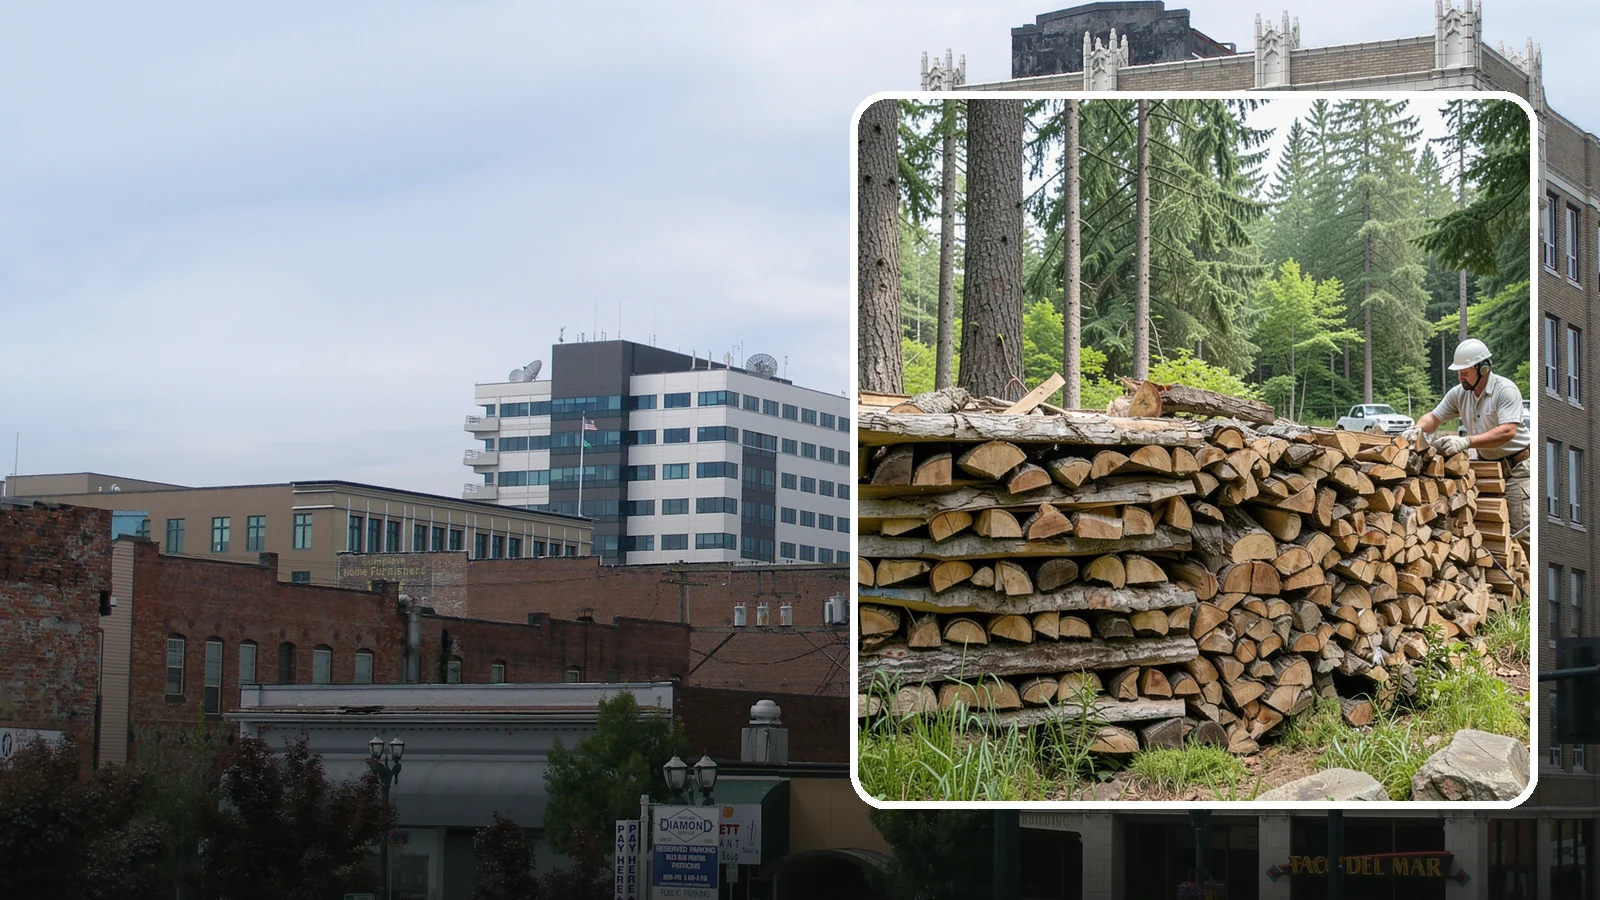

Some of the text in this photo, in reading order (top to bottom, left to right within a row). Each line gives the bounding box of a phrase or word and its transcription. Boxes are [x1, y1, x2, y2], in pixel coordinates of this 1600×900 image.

[371, 565, 427, 577] Furnishers
[660, 818, 713, 833] DIAMOND
[1022, 815, 1070, 828] BUILDING
[719, 824, 740, 835] ETT
[656, 845, 716, 854] RESERVED PARKING
[719, 839, 740, 848] ANT
[616, 825, 625, 894] PAY HERE
[627, 824, 637, 893] PAY HERE
[722, 851, 739, 861] Soup
[1346, 856, 1385, 875] DEL
[1392, 857, 1442, 877] MAR
[660, 889, 710, 898] PUBLIC PARKING
